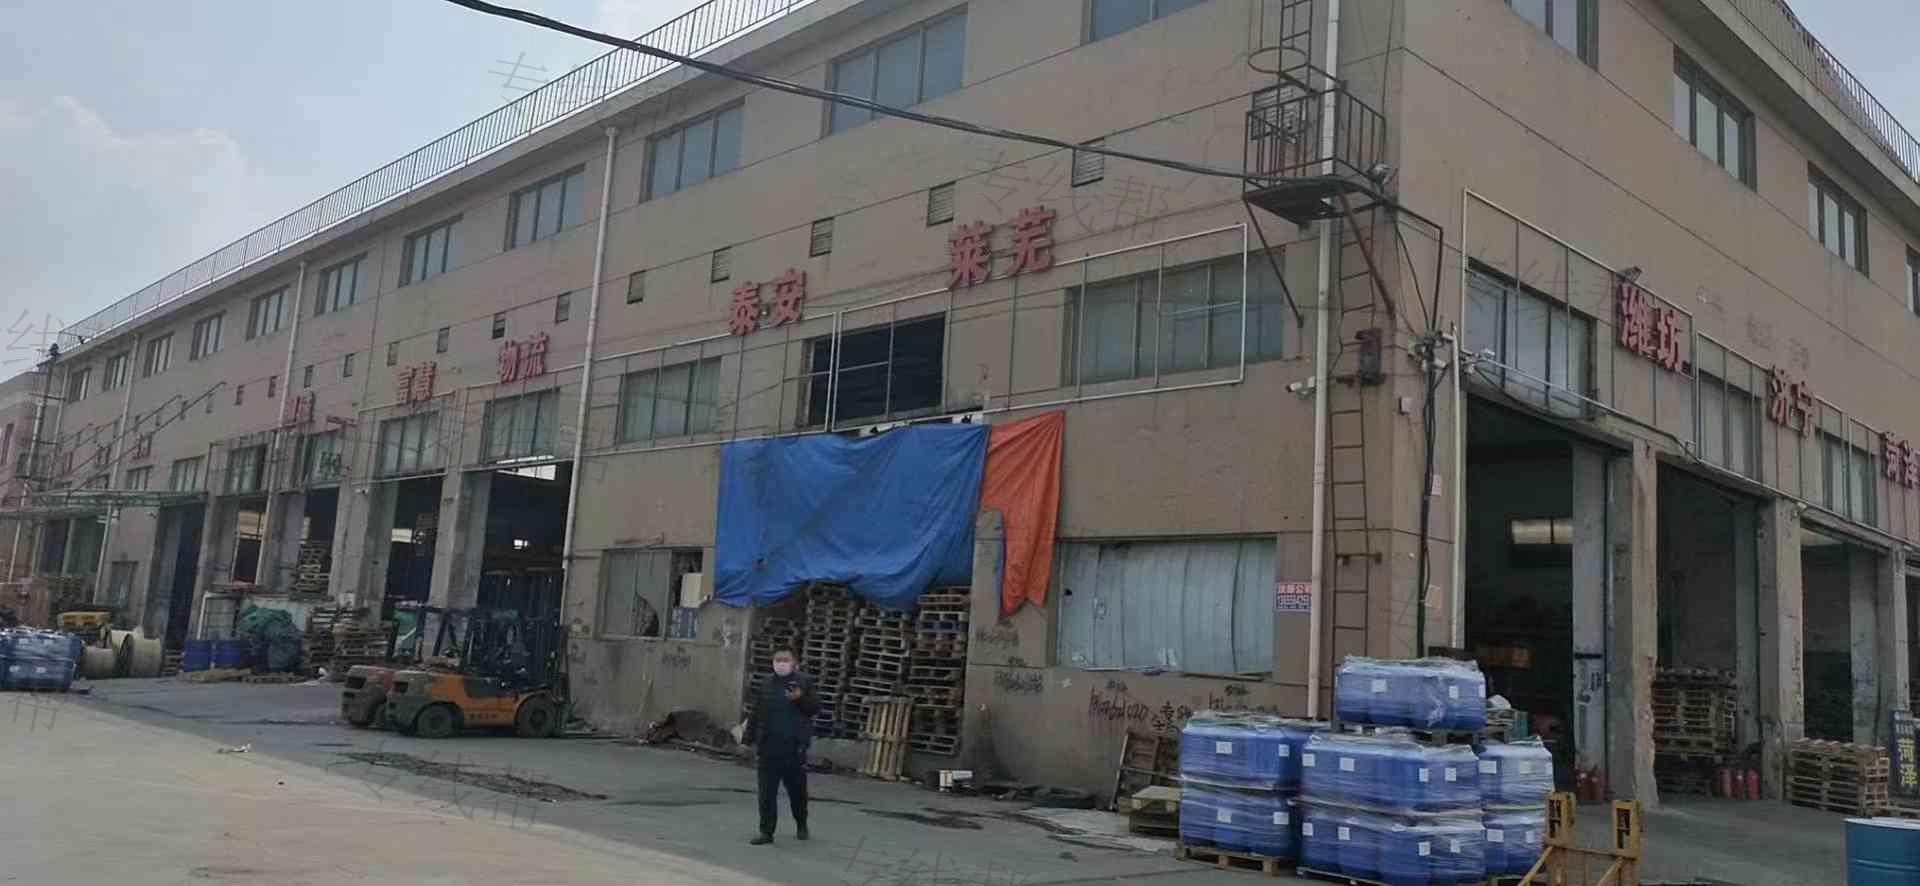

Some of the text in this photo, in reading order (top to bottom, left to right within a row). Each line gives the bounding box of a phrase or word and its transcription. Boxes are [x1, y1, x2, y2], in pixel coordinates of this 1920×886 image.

[950, 205, 1056, 288] 莱芜
[730, 268, 806, 336] 泰安
[1616, 281, 1686, 373] 潍坊
[499, 331, 549, 383] 物流
[1766, 366, 1816, 439] 济宁
